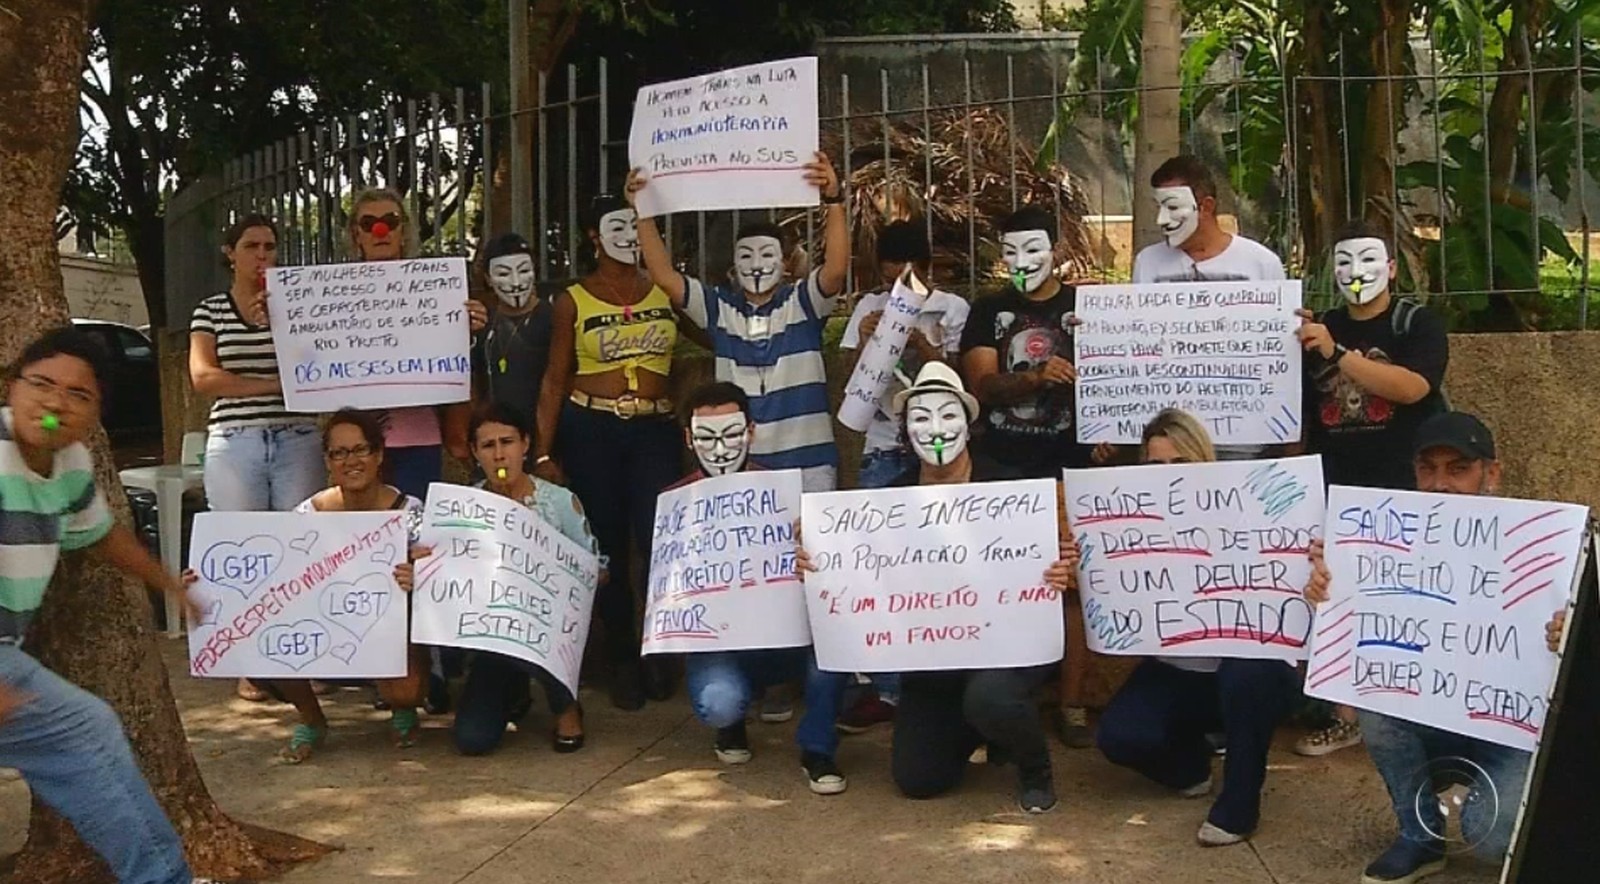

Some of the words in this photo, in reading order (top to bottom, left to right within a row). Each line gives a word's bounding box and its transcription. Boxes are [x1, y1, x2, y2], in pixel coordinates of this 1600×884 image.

[647, 86, 692, 105] HOMEM
[702, 76, 740, 94] TRANS
[747, 72, 761, 85] NA
[768, 67, 797, 82] LUTA
[759, 93, 768, 106] A
[651, 153, 717, 171] PREVISTA
[729, 150, 750, 165] NO
[757, 148, 798, 163] SUS
[277, 267, 304, 286] 75
[309, 264, 386, 283] MULHERES
[400, 260, 450, 275] TRANS
[285, 286, 315, 302] SEM
[322, 283, 376, 298] ACESSO
[386, 279, 402, 293] AO
[409, 276, 462, 293] ACETATO
[1138, 293, 1171, 308] DADA
[1188, 290, 1211, 308] NÃO
[287, 305, 303, 320] DE
[417, 297, 438, 310] NO
[289, 313, 371, 335] AMBULATÓRIO
[377, 316, 395, 328] DE
[401, 312, 440, 328] SAÚDE
[445, 309, 462, 323] TT
[1079, 321, 1098, 334] EM
[1241, 320, 1254, 332] DE
[314, 337, 339, 351] RIO
[346, 333, 399, 349] PRETO
[599, 325, 668, 360] Barbie
[1170, 340, 1225, 354] PROMETE
[1227, 339, 1252, 353] QUE
[1257, 336, 1284, 353] NÃO
[294, 360, 322, 385] 06
[328, 359, 393, 379] MESES
[397, 359, 423, 373] EM
[427, 353, 470, 375] FALTA
[1145, 363, 1261, 377] DESCONTINUIDADE
[1268, 360, 1288, 375] NO
[1079, 382, 1171, 399] FORNECIMENTO
[1176, 381, 1192, 394] DO
[1198, 382, 1255, 396] ACETATO
[1260, 382, 1274, 395] DE
[692, 489, 787, 525] INTEGRAL
[1075, 487, 1157, 519] SAÚDE
[1169, 477, 1186, 516] É
[1196, 487, 1243, 513] UM
[434, 497, 496, 524] SAÚDE
[504, 507, 517, 531] É
[522, 521, 549, 546] UM
[819, 501, 907, 534] SAÚDE
[918, 492, 1046, 529] INTEGRAL
[1335, 497, 1419, 546] SAÚDE
[1426, 501, 1445, 545] É
[1453, 516, 1499, 550] UM
[815, 551, 842, 572] DA
[978, 536, 1042, 562] TRANS
[1101, 526, 1212, 555] DIREITO
[1219, 527, 1249, 551] DE
[209, 554, 273, 584] LGBT
[452, 537, 480, 559] DE
[495, 541, 559, 595] TODOS
[739, 559, 752, 582] E
[1355, 551, 1453, 595] DIREITO
[1469, 564, 1501, 599] DE
[431, 578, 473, 604] UM
[1089, 569, 1110, 595] E
[1119, 567, 1176, 593] UM
[329, 591, 389, 617] LGBT
[852, 597, 875, 614] UM
[889, 585, 978, 614] DIREITO
[458, 612, 549, 654] ESTADO
[1113, 608, 1142, 634] DO
[1155, 596, 1313, 647] ESTADO
[265, 631, 324, 657] LGBT
[865, 630, 892, 647] UM
[1353, 612, 1431, 648] TODOS
[1441, 622, 1457, 651] E
[1465, 624, 1519, 660] UM
[1432, 669, 1457, 698] DO
[1465, 680, 1547, 725] ESTADO
